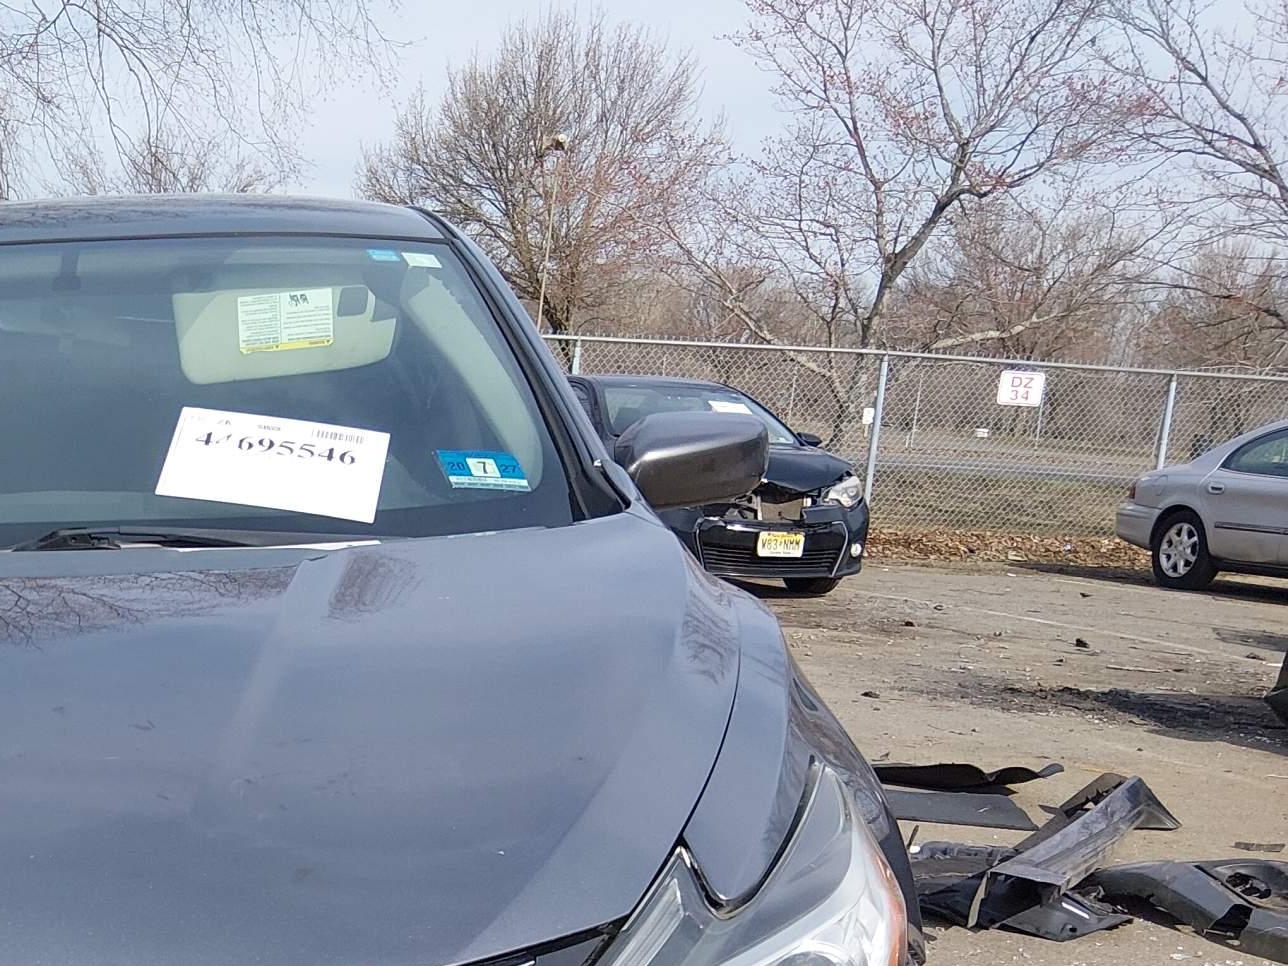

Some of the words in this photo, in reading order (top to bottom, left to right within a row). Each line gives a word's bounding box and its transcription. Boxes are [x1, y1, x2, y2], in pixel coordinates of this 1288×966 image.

[1011, 376, 1035, 389] DZ
[1009, 389, 1030, 401] 34
[476, 461, 488, 475] 7
